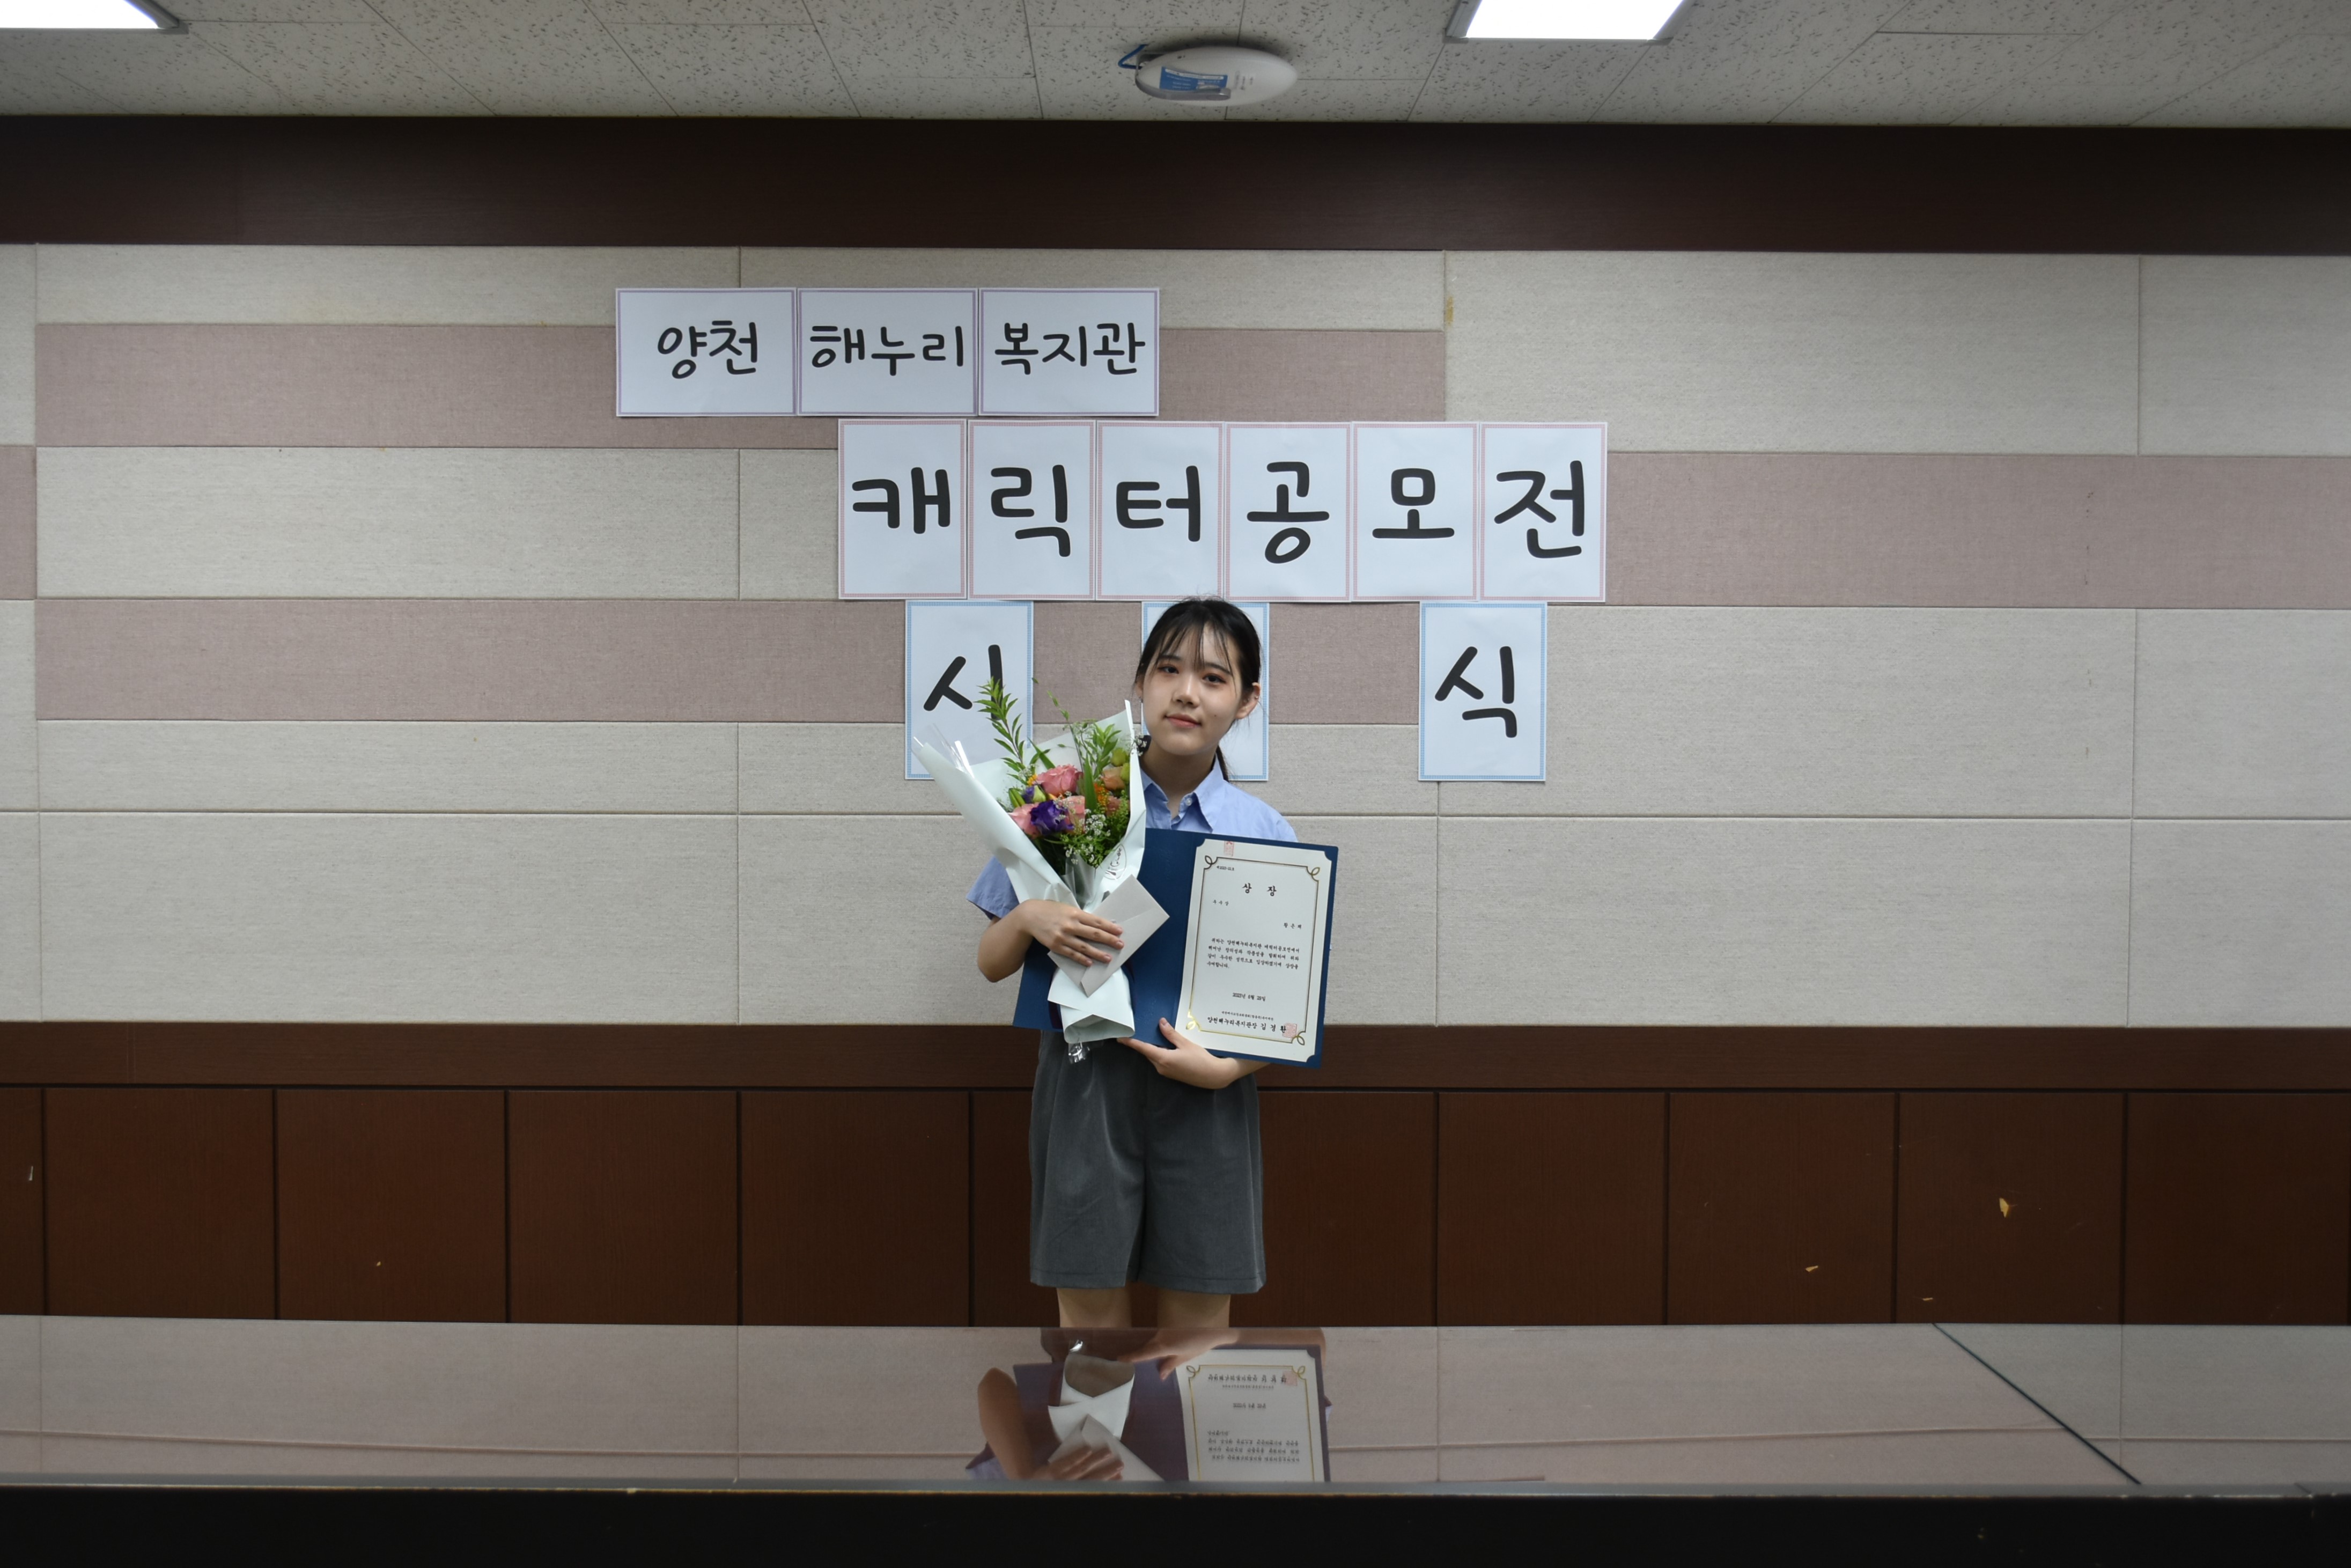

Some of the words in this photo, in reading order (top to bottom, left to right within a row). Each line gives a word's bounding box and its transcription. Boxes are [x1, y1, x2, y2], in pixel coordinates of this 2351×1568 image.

[657, 319, 758, 380] 양천
[809, 325, 964, 377] 해누리
[994, 321, 1146, 376] 복지관
[851, 459, 1586, 565] 캐릭터공모전
[1434, 645, 1518, 739] 식
